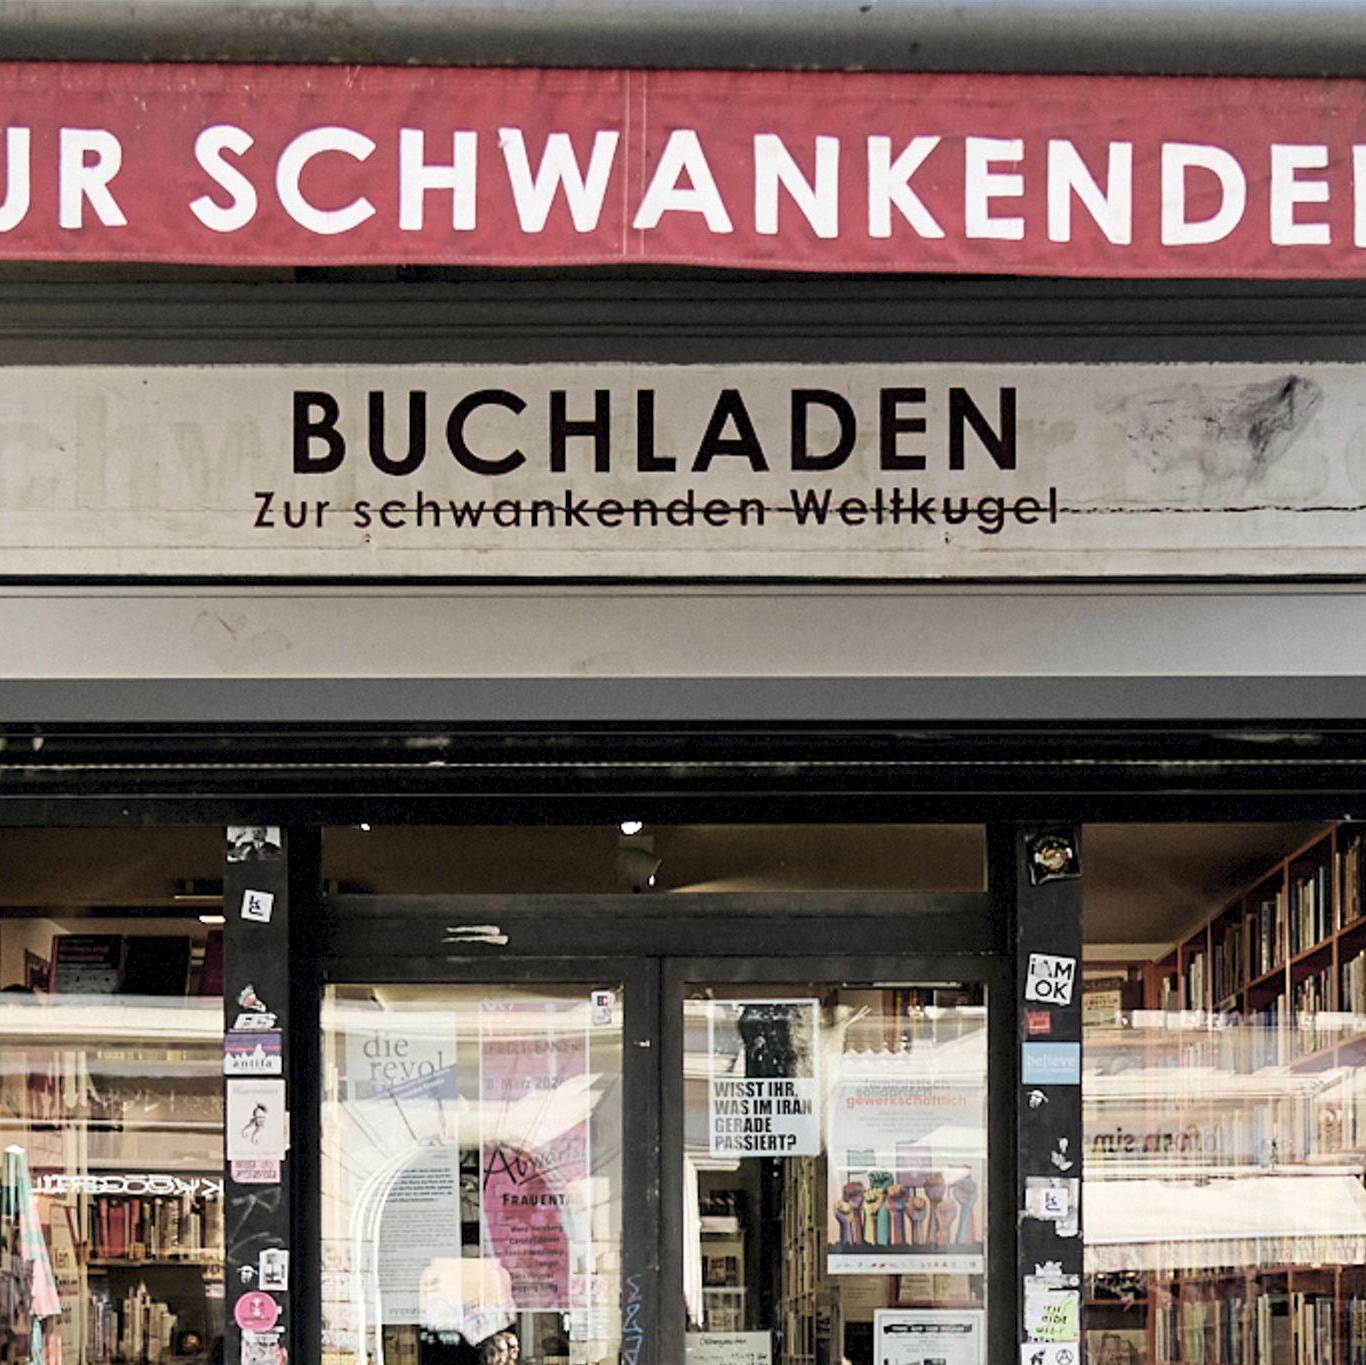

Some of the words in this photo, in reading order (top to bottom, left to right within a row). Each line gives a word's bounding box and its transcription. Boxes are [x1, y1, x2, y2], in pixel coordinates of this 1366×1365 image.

[292, 387, 1018, 476] BUCHLADEN
[253, 492, 330, 529] Zur
[354, 489, 766, 529] schwankenden
[790, 486, 1059, 534] Weltkugel
[1034, 980, 1066, 999] OK
[363, 1031, 410, 1058] die
[232, 1058, 273, 1070] antifa
[1027, 1053, 1077, 1068] believe
[714, 1081, 765, 1098] WISST
[767, 1080, 799, 1099] IHR,
[714, 1099, 749, 1116] WAS
[752, 1099, 773, 1115] IM
[776, 1099, 813, 1115] IRAN
[845, 1094, 968, 1110] gewerkschaftlich
[714, 1116, 773, 1133] GERADE
[714, 1133, 798, 1151] PASSIERT?
